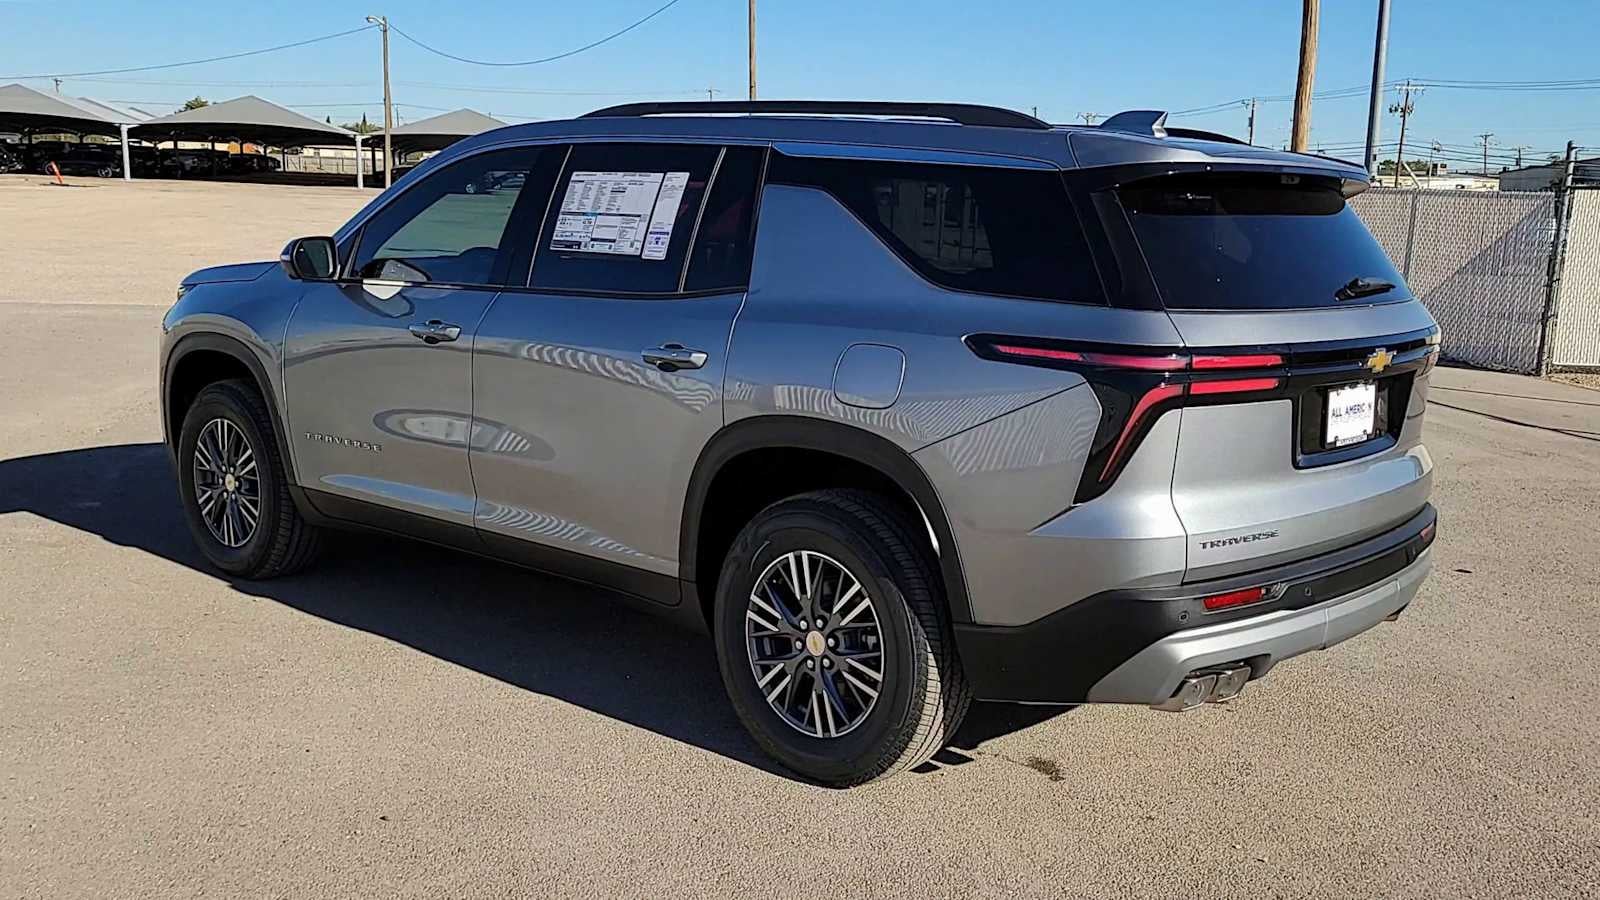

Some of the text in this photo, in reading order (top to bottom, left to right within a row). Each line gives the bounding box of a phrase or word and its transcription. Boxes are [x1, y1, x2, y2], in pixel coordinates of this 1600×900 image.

[1331, 407, 1342, 417] ALL
[304, 431, 382, 452] TRAVERSE
[1199, 529, 1279, 550] TRAVERSE
